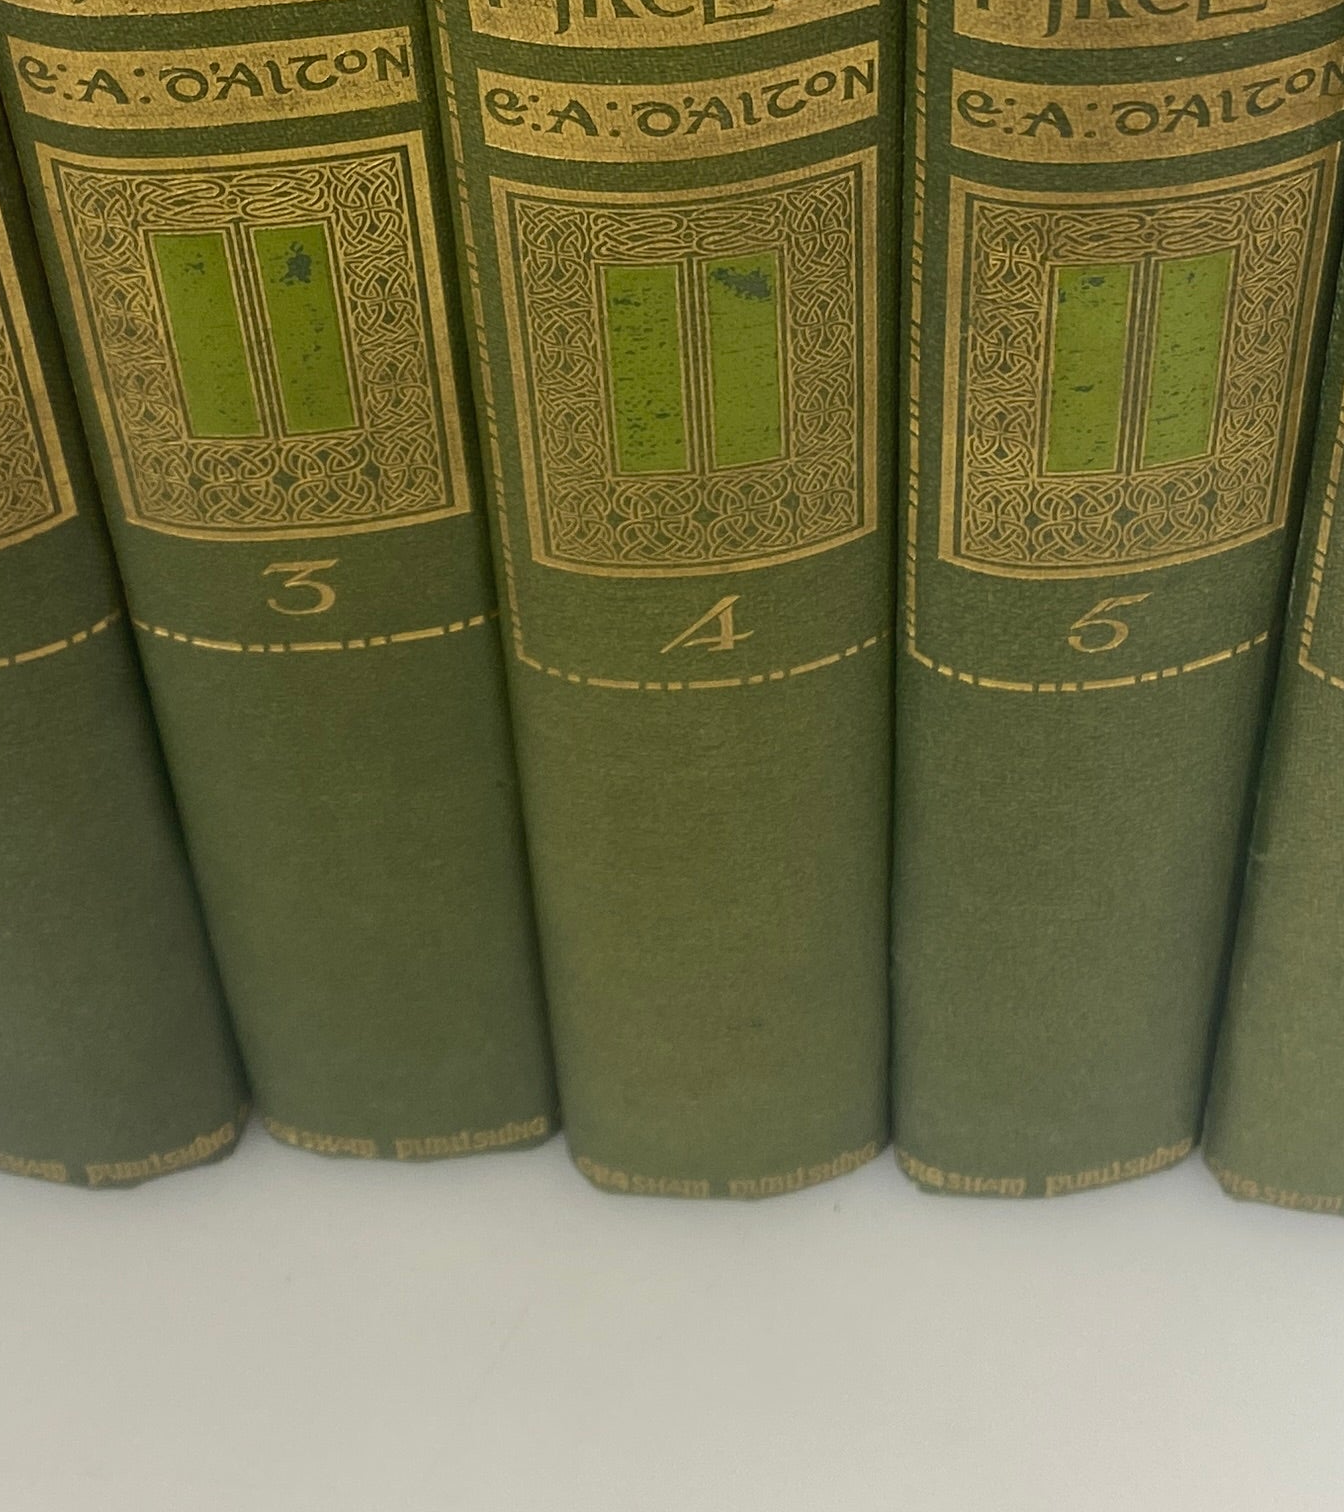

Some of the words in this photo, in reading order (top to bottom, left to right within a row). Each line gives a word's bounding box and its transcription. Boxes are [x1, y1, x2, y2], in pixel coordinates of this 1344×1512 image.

[260, 558, 340, 616] 3
[659, 593, 755, 654] 4
[1066, 592, 1155, 653] 5
